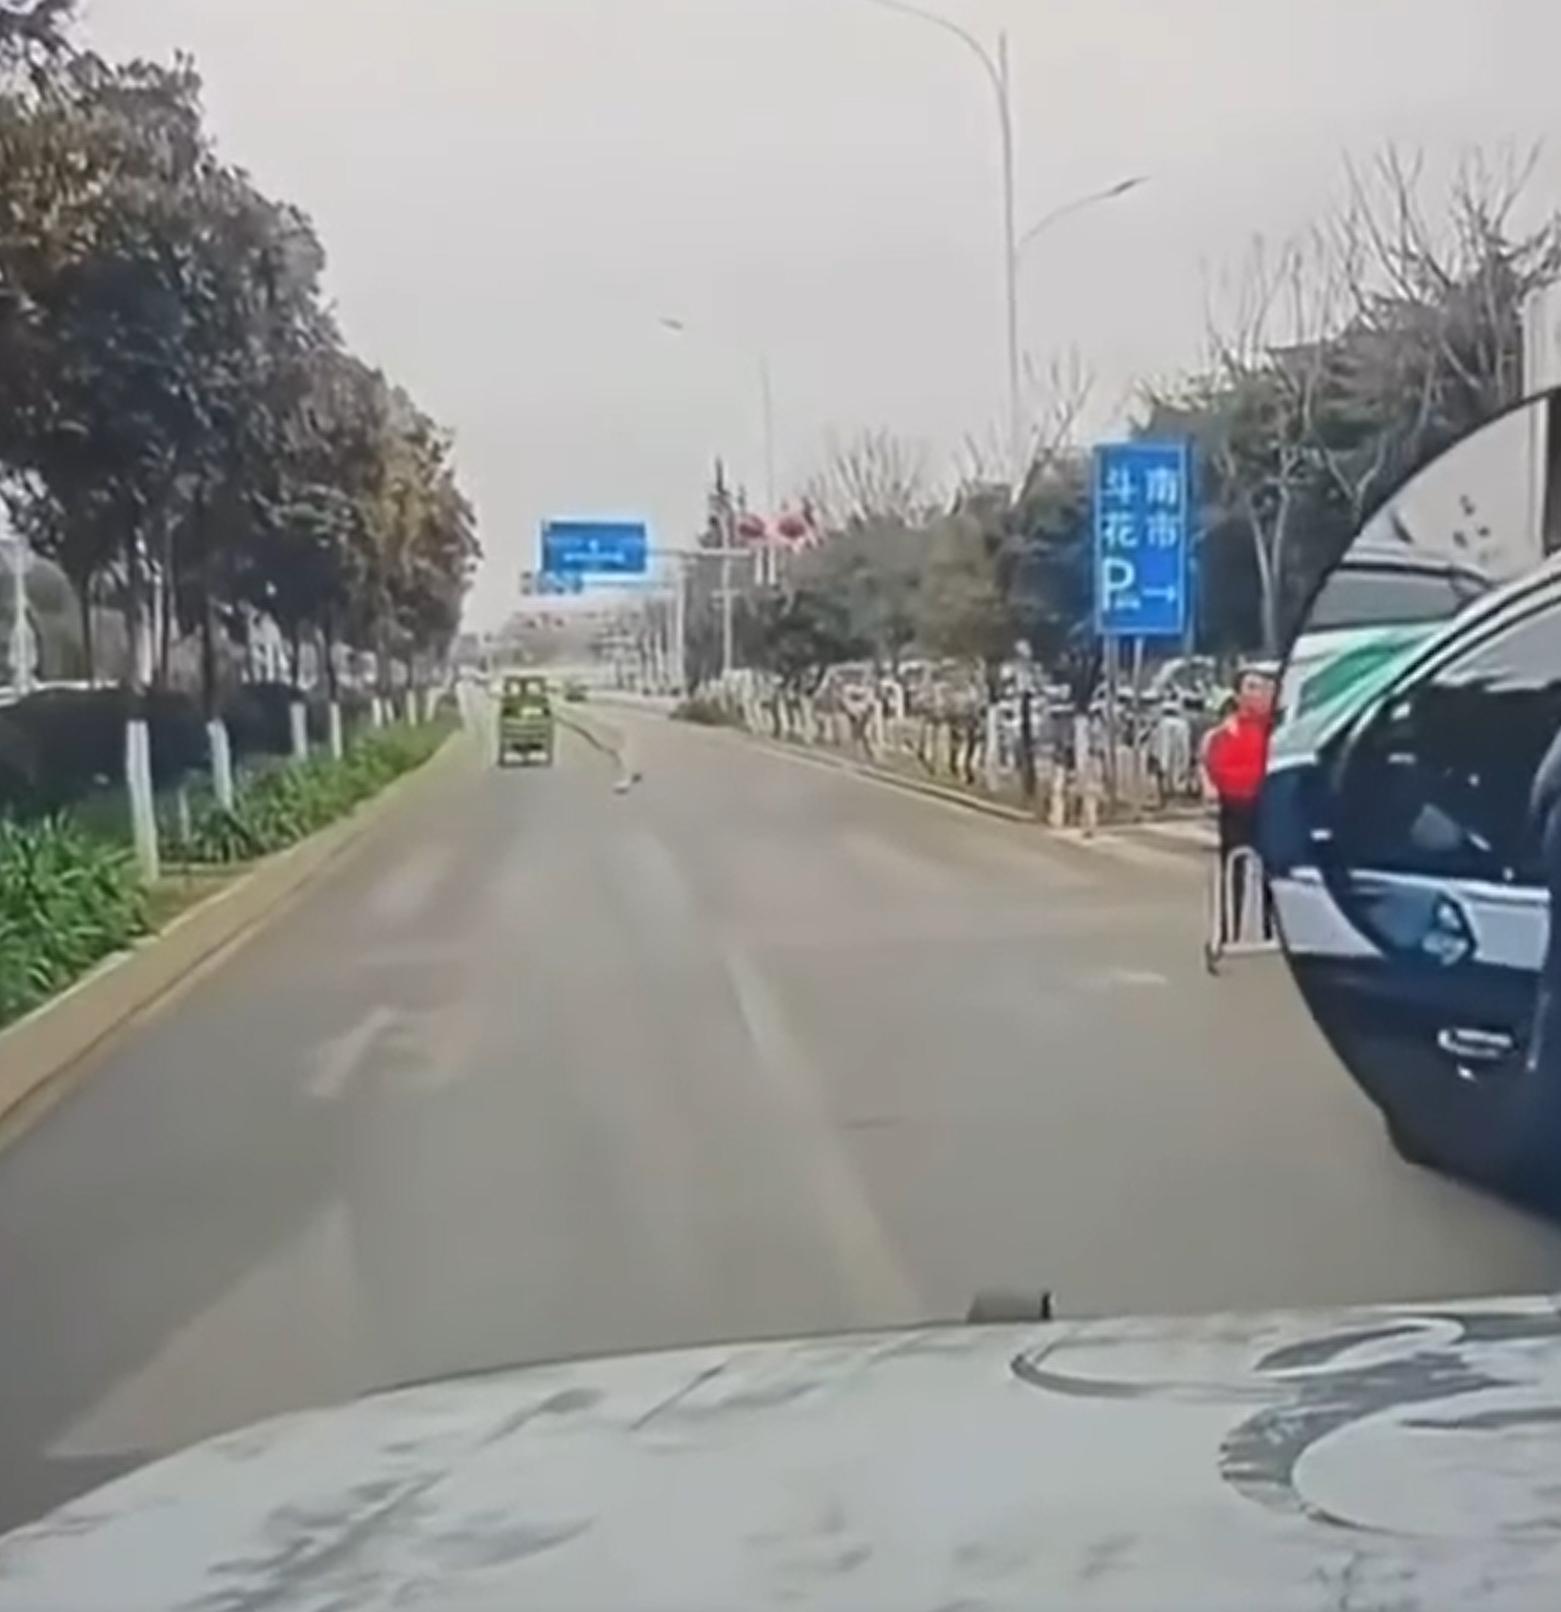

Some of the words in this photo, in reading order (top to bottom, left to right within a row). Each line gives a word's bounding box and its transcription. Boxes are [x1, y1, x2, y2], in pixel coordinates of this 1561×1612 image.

[1101, 468, 1178, 505] 斗南
[1102, 510, 1178, 548] 花市
[1103, 557, 1135, 611] P
